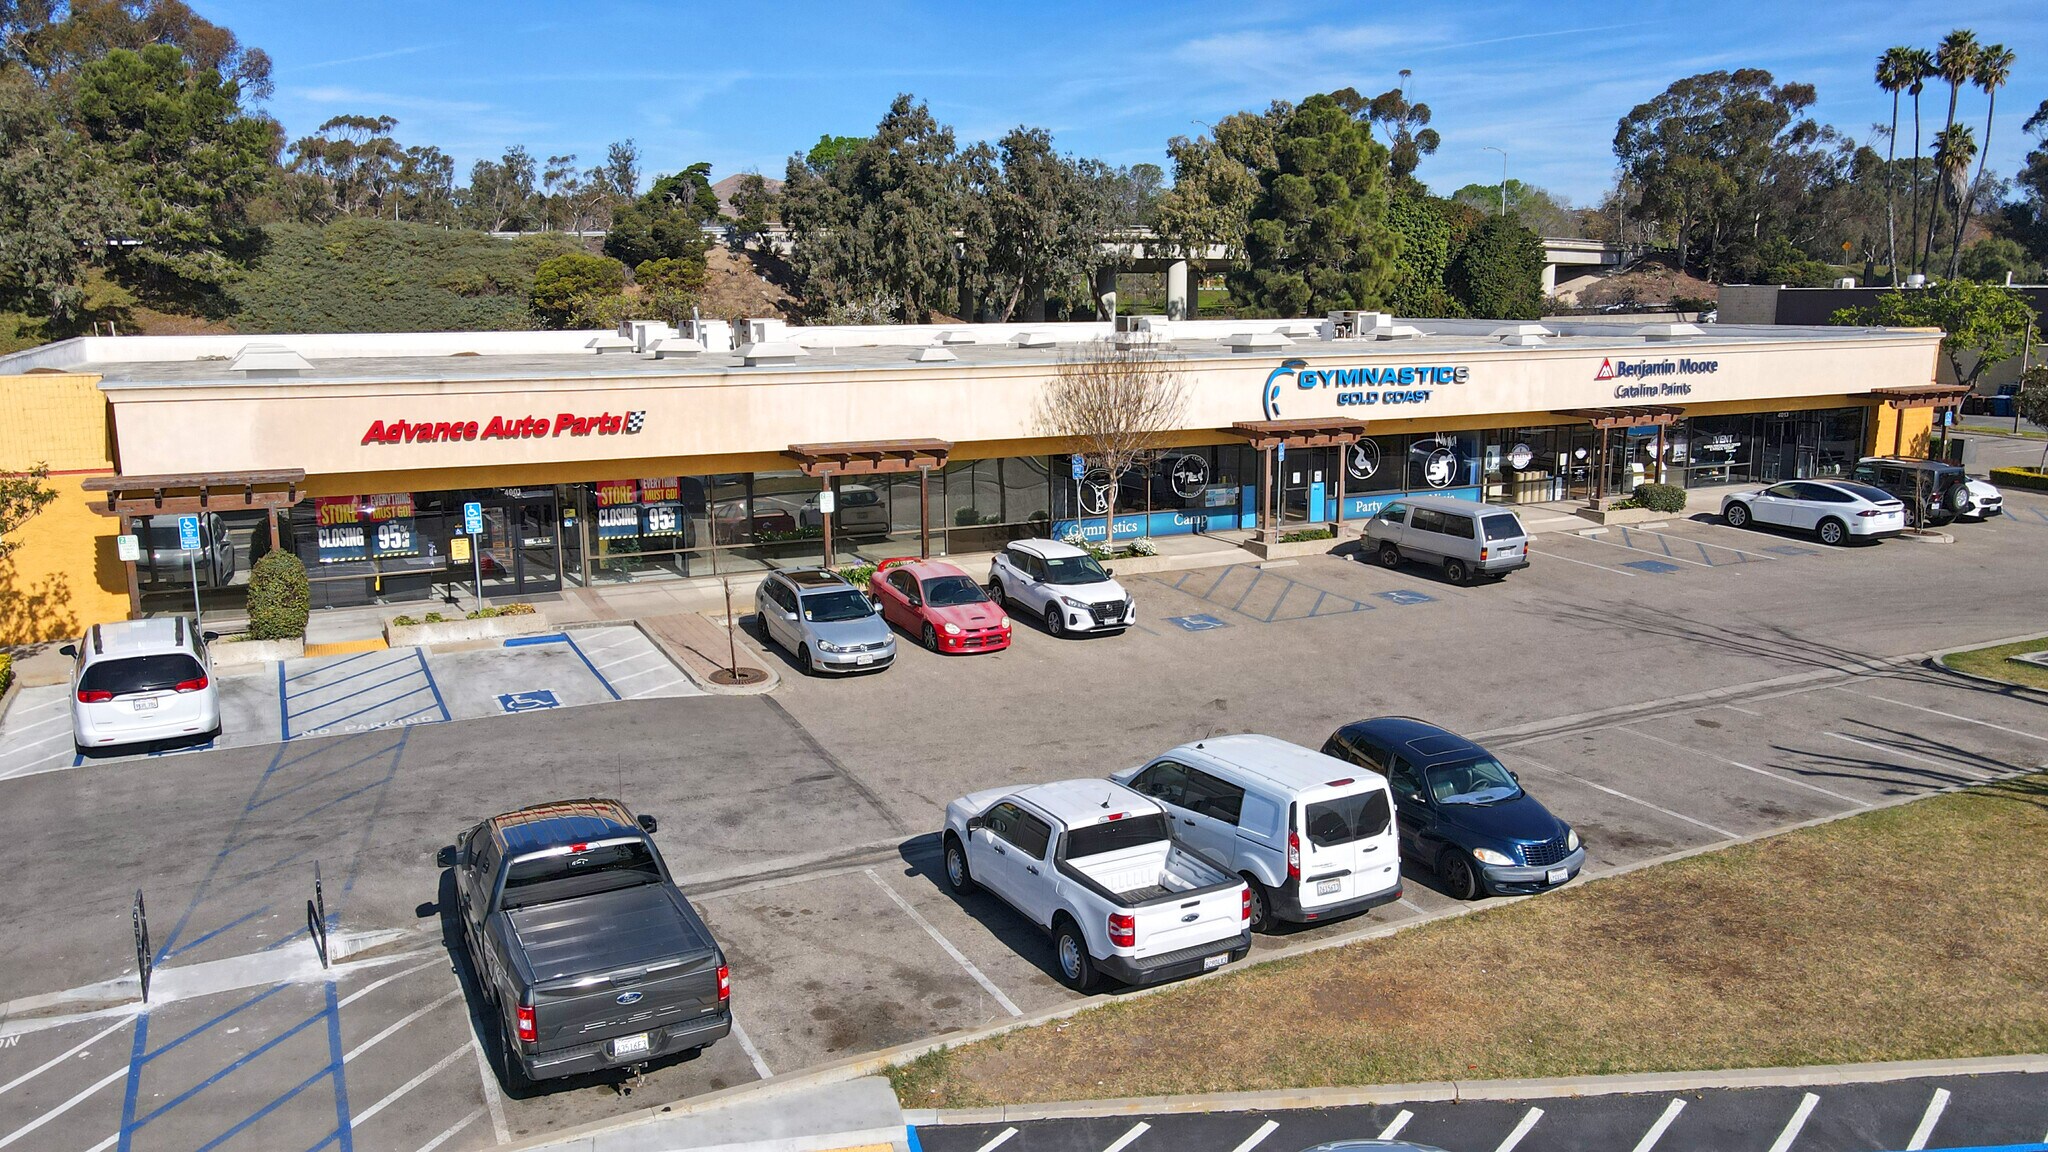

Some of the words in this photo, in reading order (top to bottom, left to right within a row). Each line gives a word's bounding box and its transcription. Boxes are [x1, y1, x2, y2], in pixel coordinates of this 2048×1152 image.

[1299, 366, 1469, 389] GYMNASTICS
[1616, 360, 1675, 379] Benjamin
[1679, 358, 1718, 374] Moore
[1337, 392, 1378, 406] GOLD
[1383, 390, 1432, 405] COAST
[1615, 384, 1658, 399] Catalina
[1660, 382, 1691, 396] Paints
[361, 419, 478, 445] Advance
[480, 415, 550, 441] Auto
[552, 412, 621, 437] Parts
[643, 476, 677, 489] EVERYTHING
[371, 493, 411, 507] EVERYTHING
[601, 486, 632, 505] STORE
[644, 489, 664, 500] MUST
[665, 488, 677, 499] GO!
[321, 504, 359, 524] STORE
[373, 506, 396, 519] MUST
[397, 505, 411, 517] GO!
[1356, 501, 1382, 514] Party
[599, 508, 637, 527] CLOSING
[1174, 513, 1208, 527] Camp
[318, 527, 364, 548] CLOSING
[1069, 520, 1138, 541] Gymnstics
[301, 728, 330, 737] NO
[344, 716, 433, 732] PARKING
